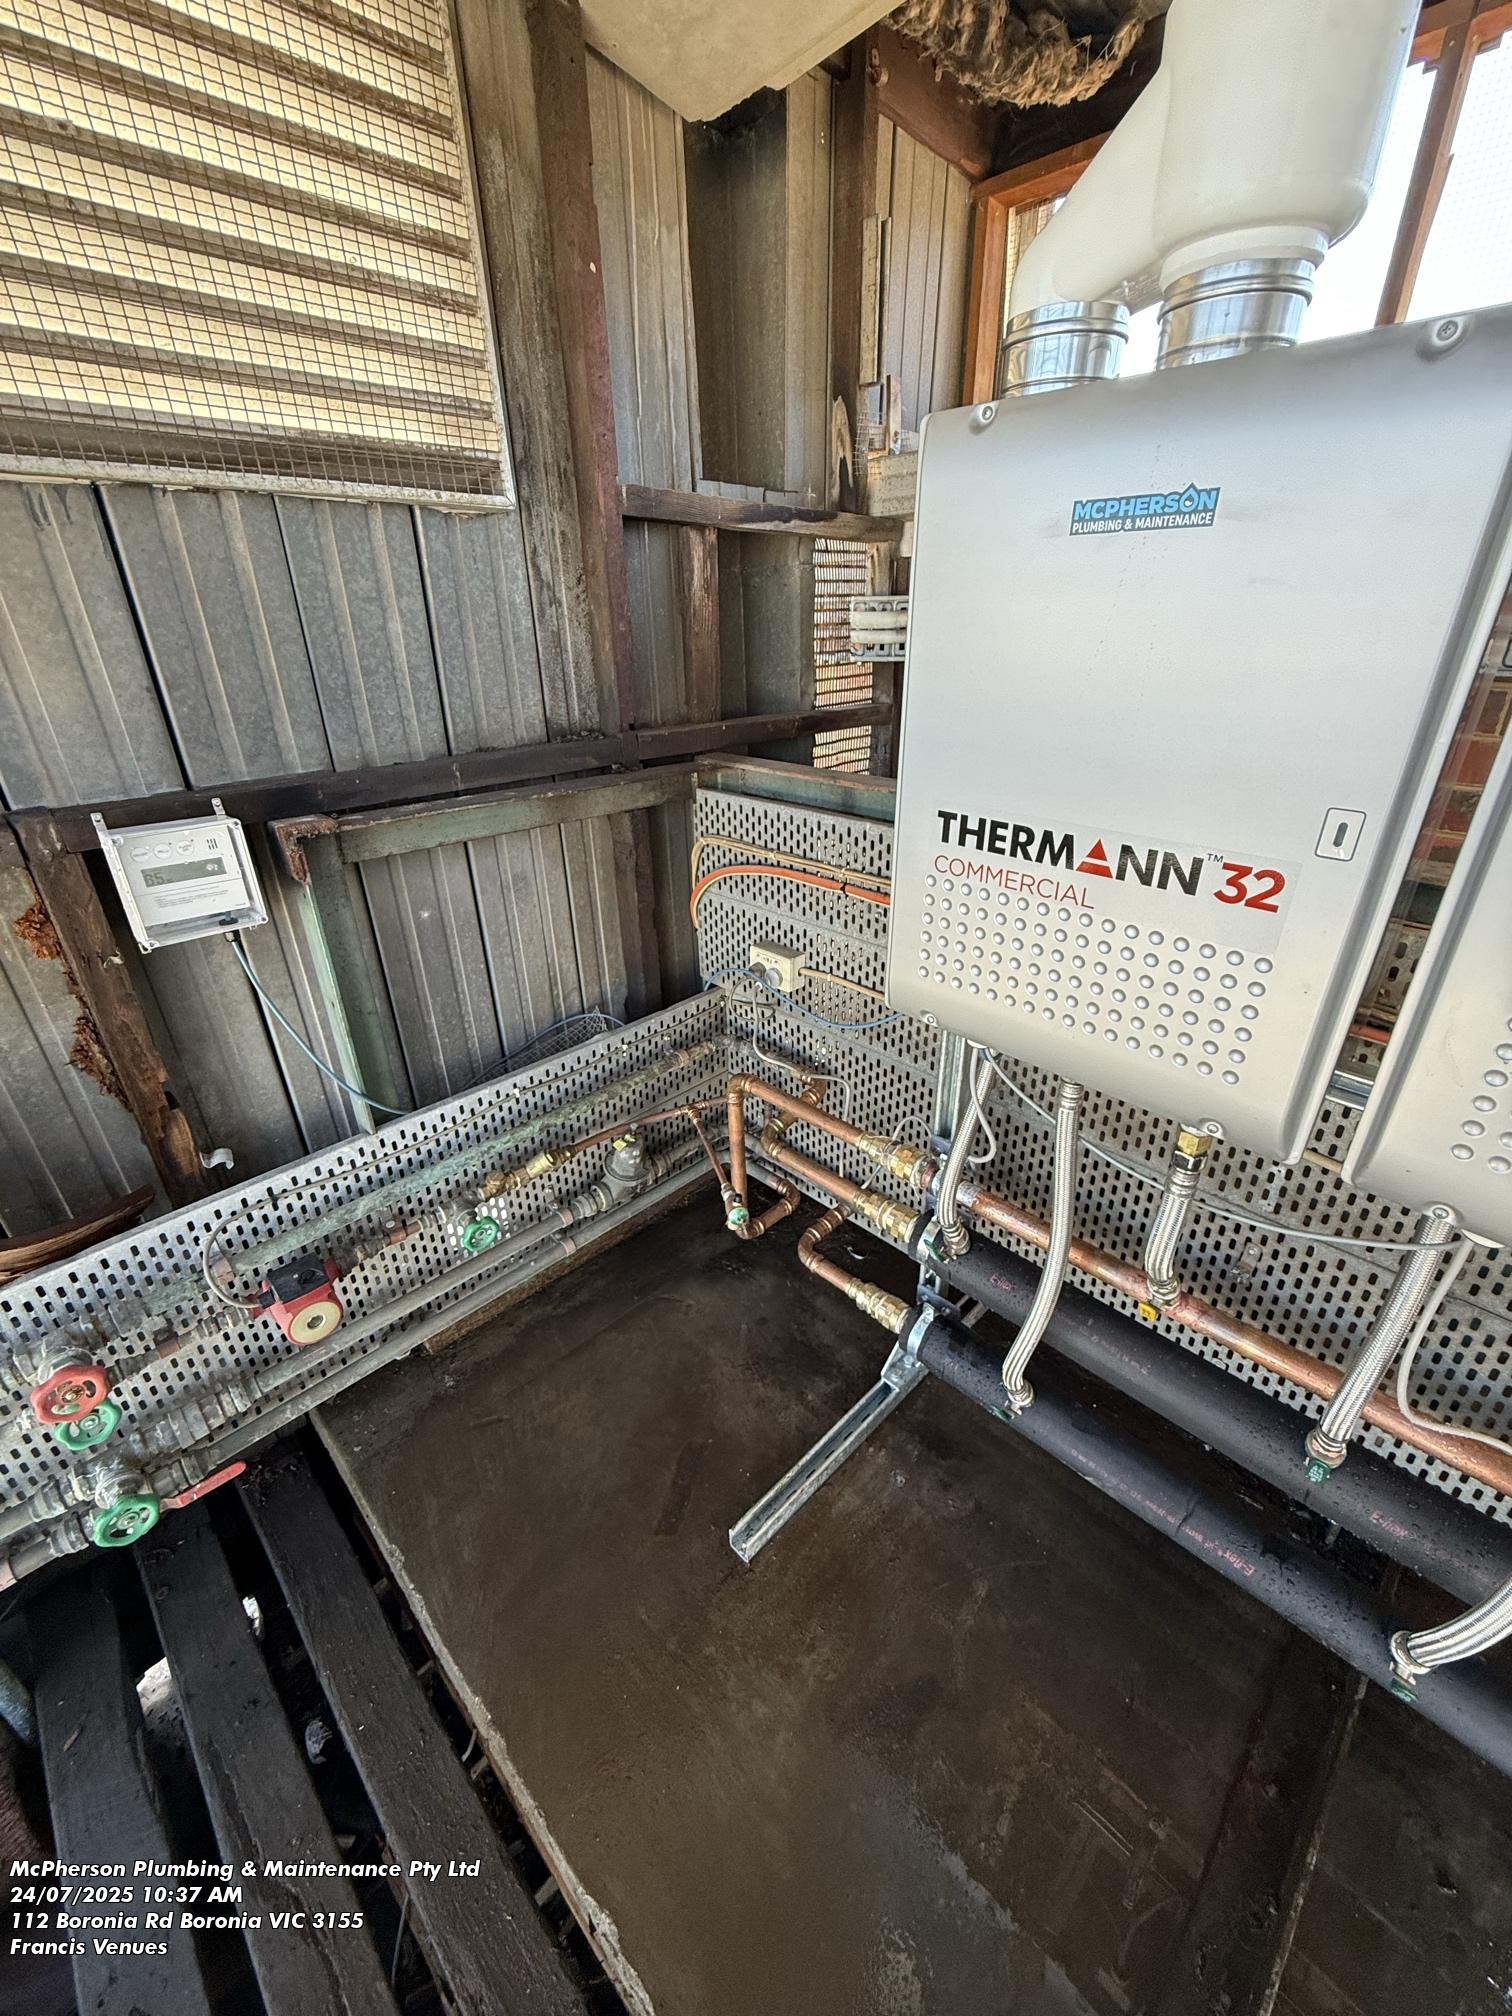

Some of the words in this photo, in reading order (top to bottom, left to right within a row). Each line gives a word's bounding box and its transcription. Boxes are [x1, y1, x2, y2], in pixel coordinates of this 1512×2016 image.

[1072, 519, 1123, 534] PLUMBING
[1124, 519, 1133, 530] &
[1134, 511, 1214, 530] MAINTENANCE
[1073, 486, 1218, 520] MCPHERSON
[933, 854, 1096, 910] COMMERCIAL
[1212, 861, 1287, 914] 32
